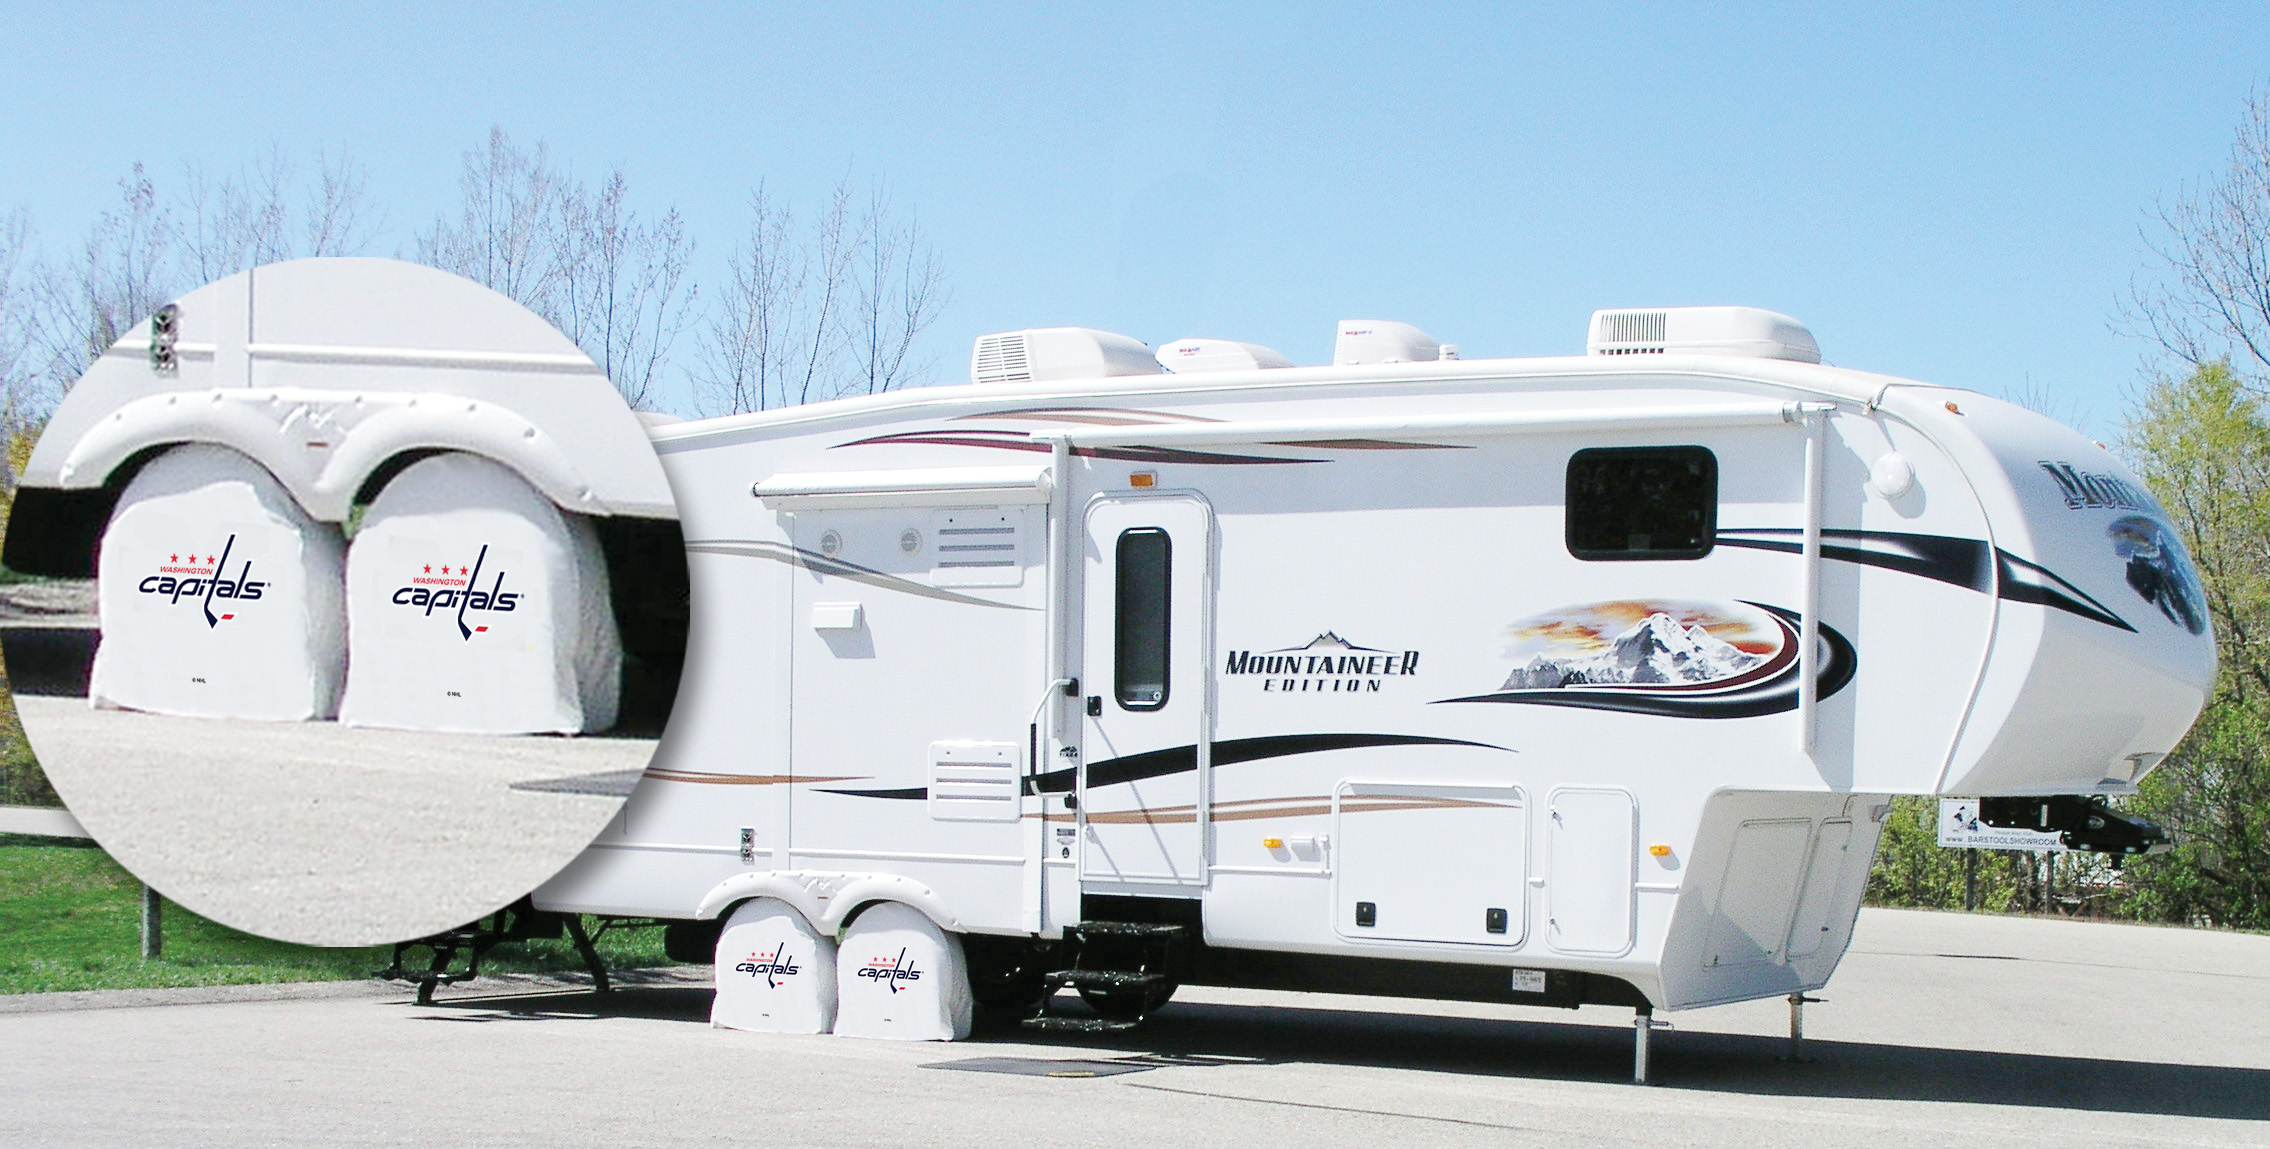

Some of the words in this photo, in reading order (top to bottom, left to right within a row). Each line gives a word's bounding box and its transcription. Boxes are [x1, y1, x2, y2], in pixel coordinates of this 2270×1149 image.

[159, 565, 214, 576] WASHINGTON
[412, 576, 467, 587] WASHINGTON
[1225, 650, 1420, 676] MOUNTAINEER
[1263, 678, 1381, 692] EDITION
[1967, 835, 2057, 846] BARSTOOLSHOWROOM
